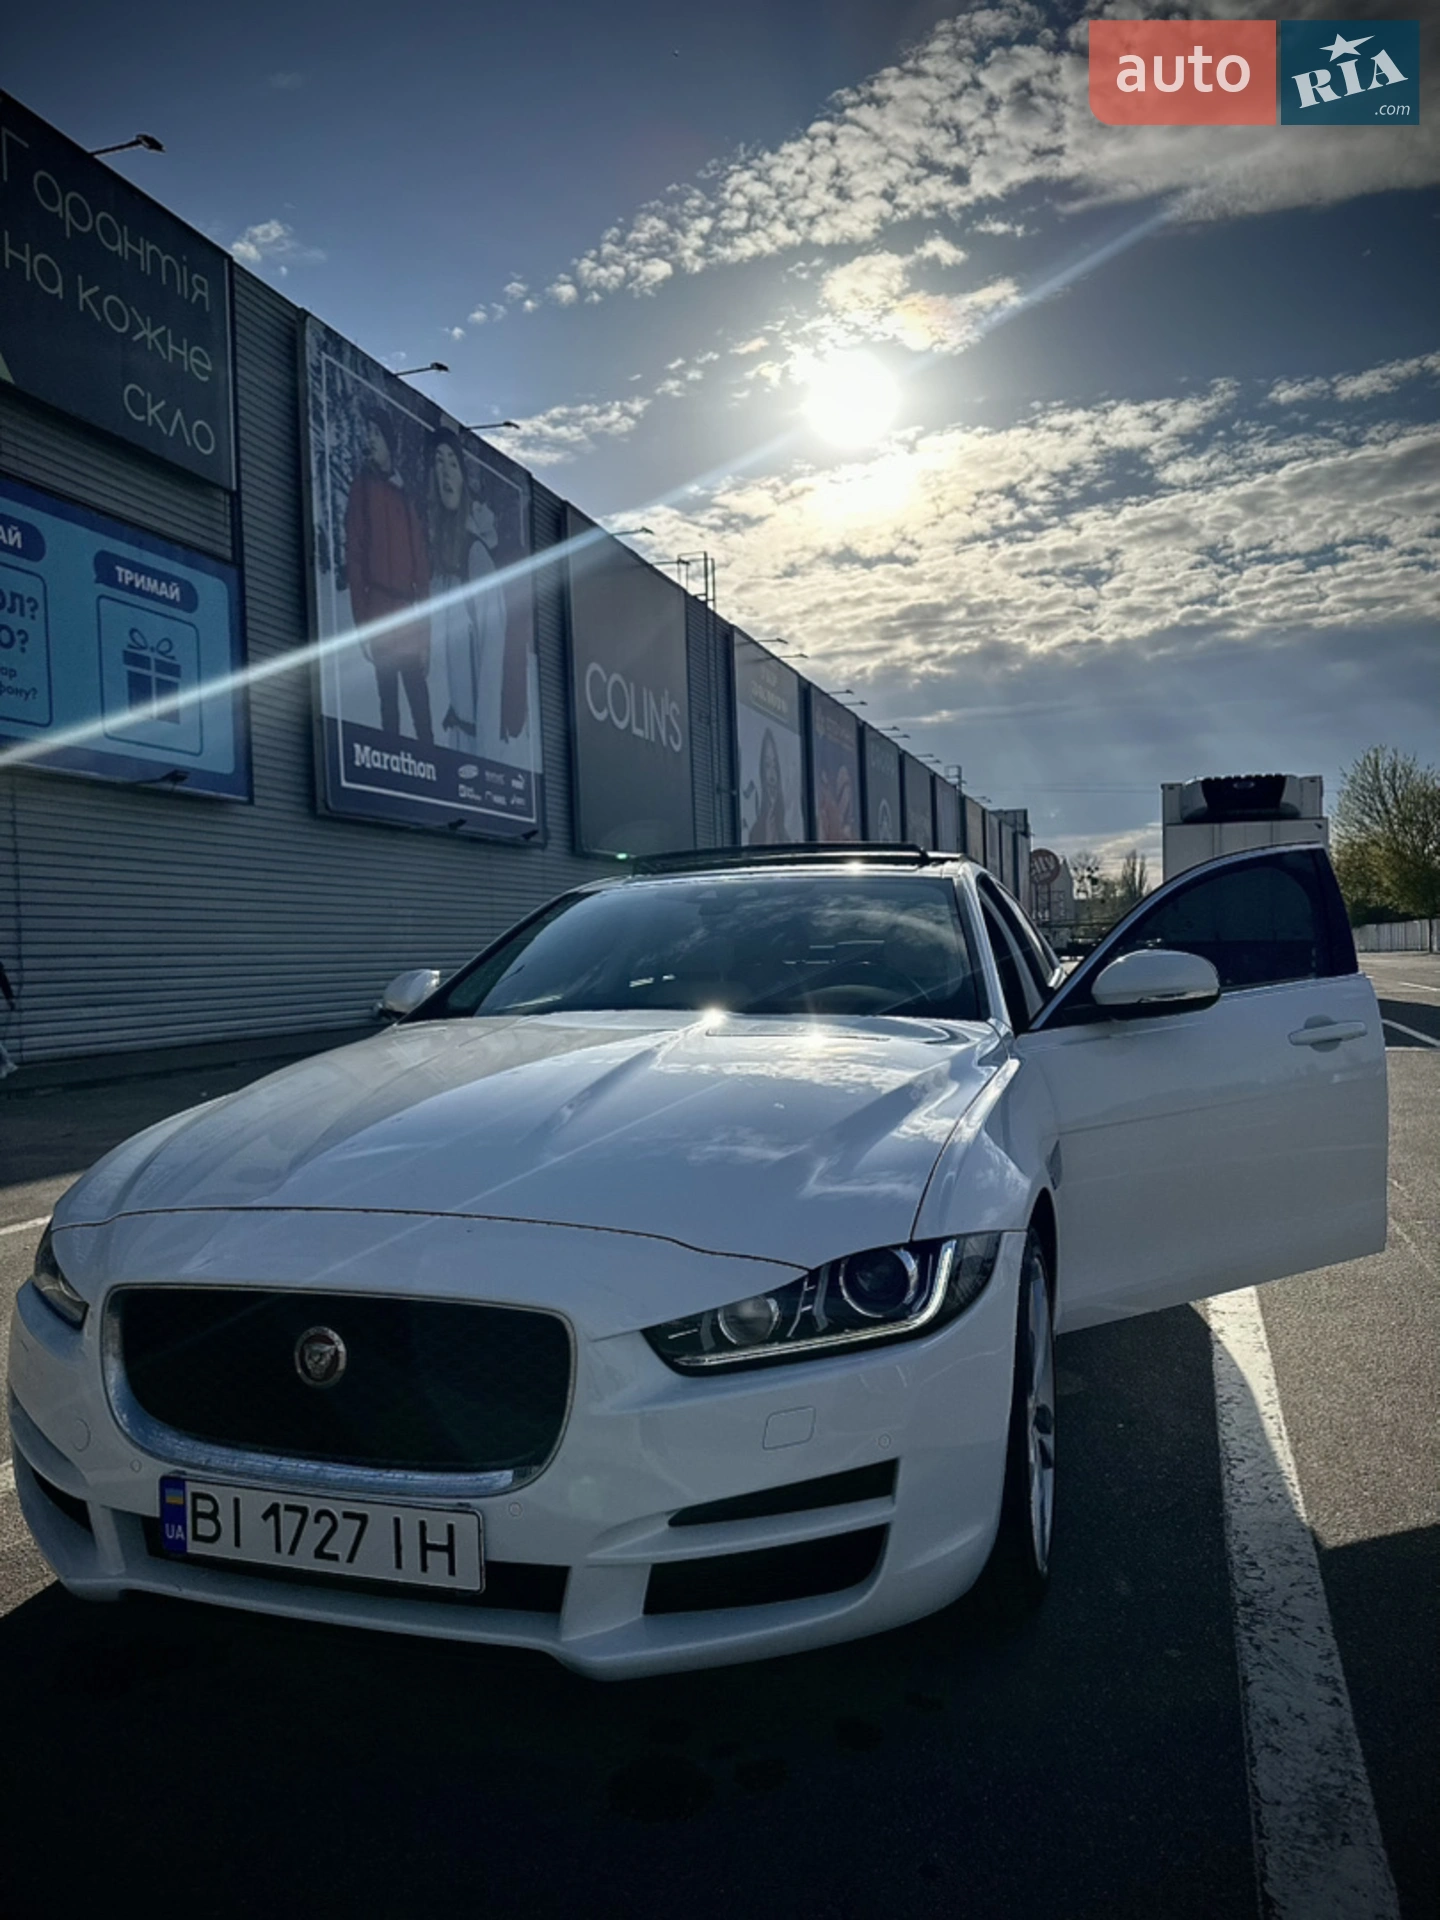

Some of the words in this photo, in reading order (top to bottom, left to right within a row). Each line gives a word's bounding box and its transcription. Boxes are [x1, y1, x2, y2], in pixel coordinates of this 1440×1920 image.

[1, 126, 210, 312] Гарантія
[4, 230, 63, 299] на
[77, 274, 212, 382] кожне
[123, 383, 215, 455] скло
[115, 565, 180, 602] ТРИМАЙ
[585, 662, 682, 752] COLIN'S
[353, 743, 437, 781] Marathon
[166, 1523, 185, 1541] UA
[191, 1492, 241, 1548] BI
[262, 1503, 369, 1563] 1727
[394, 1517, 456, 1577] IH
